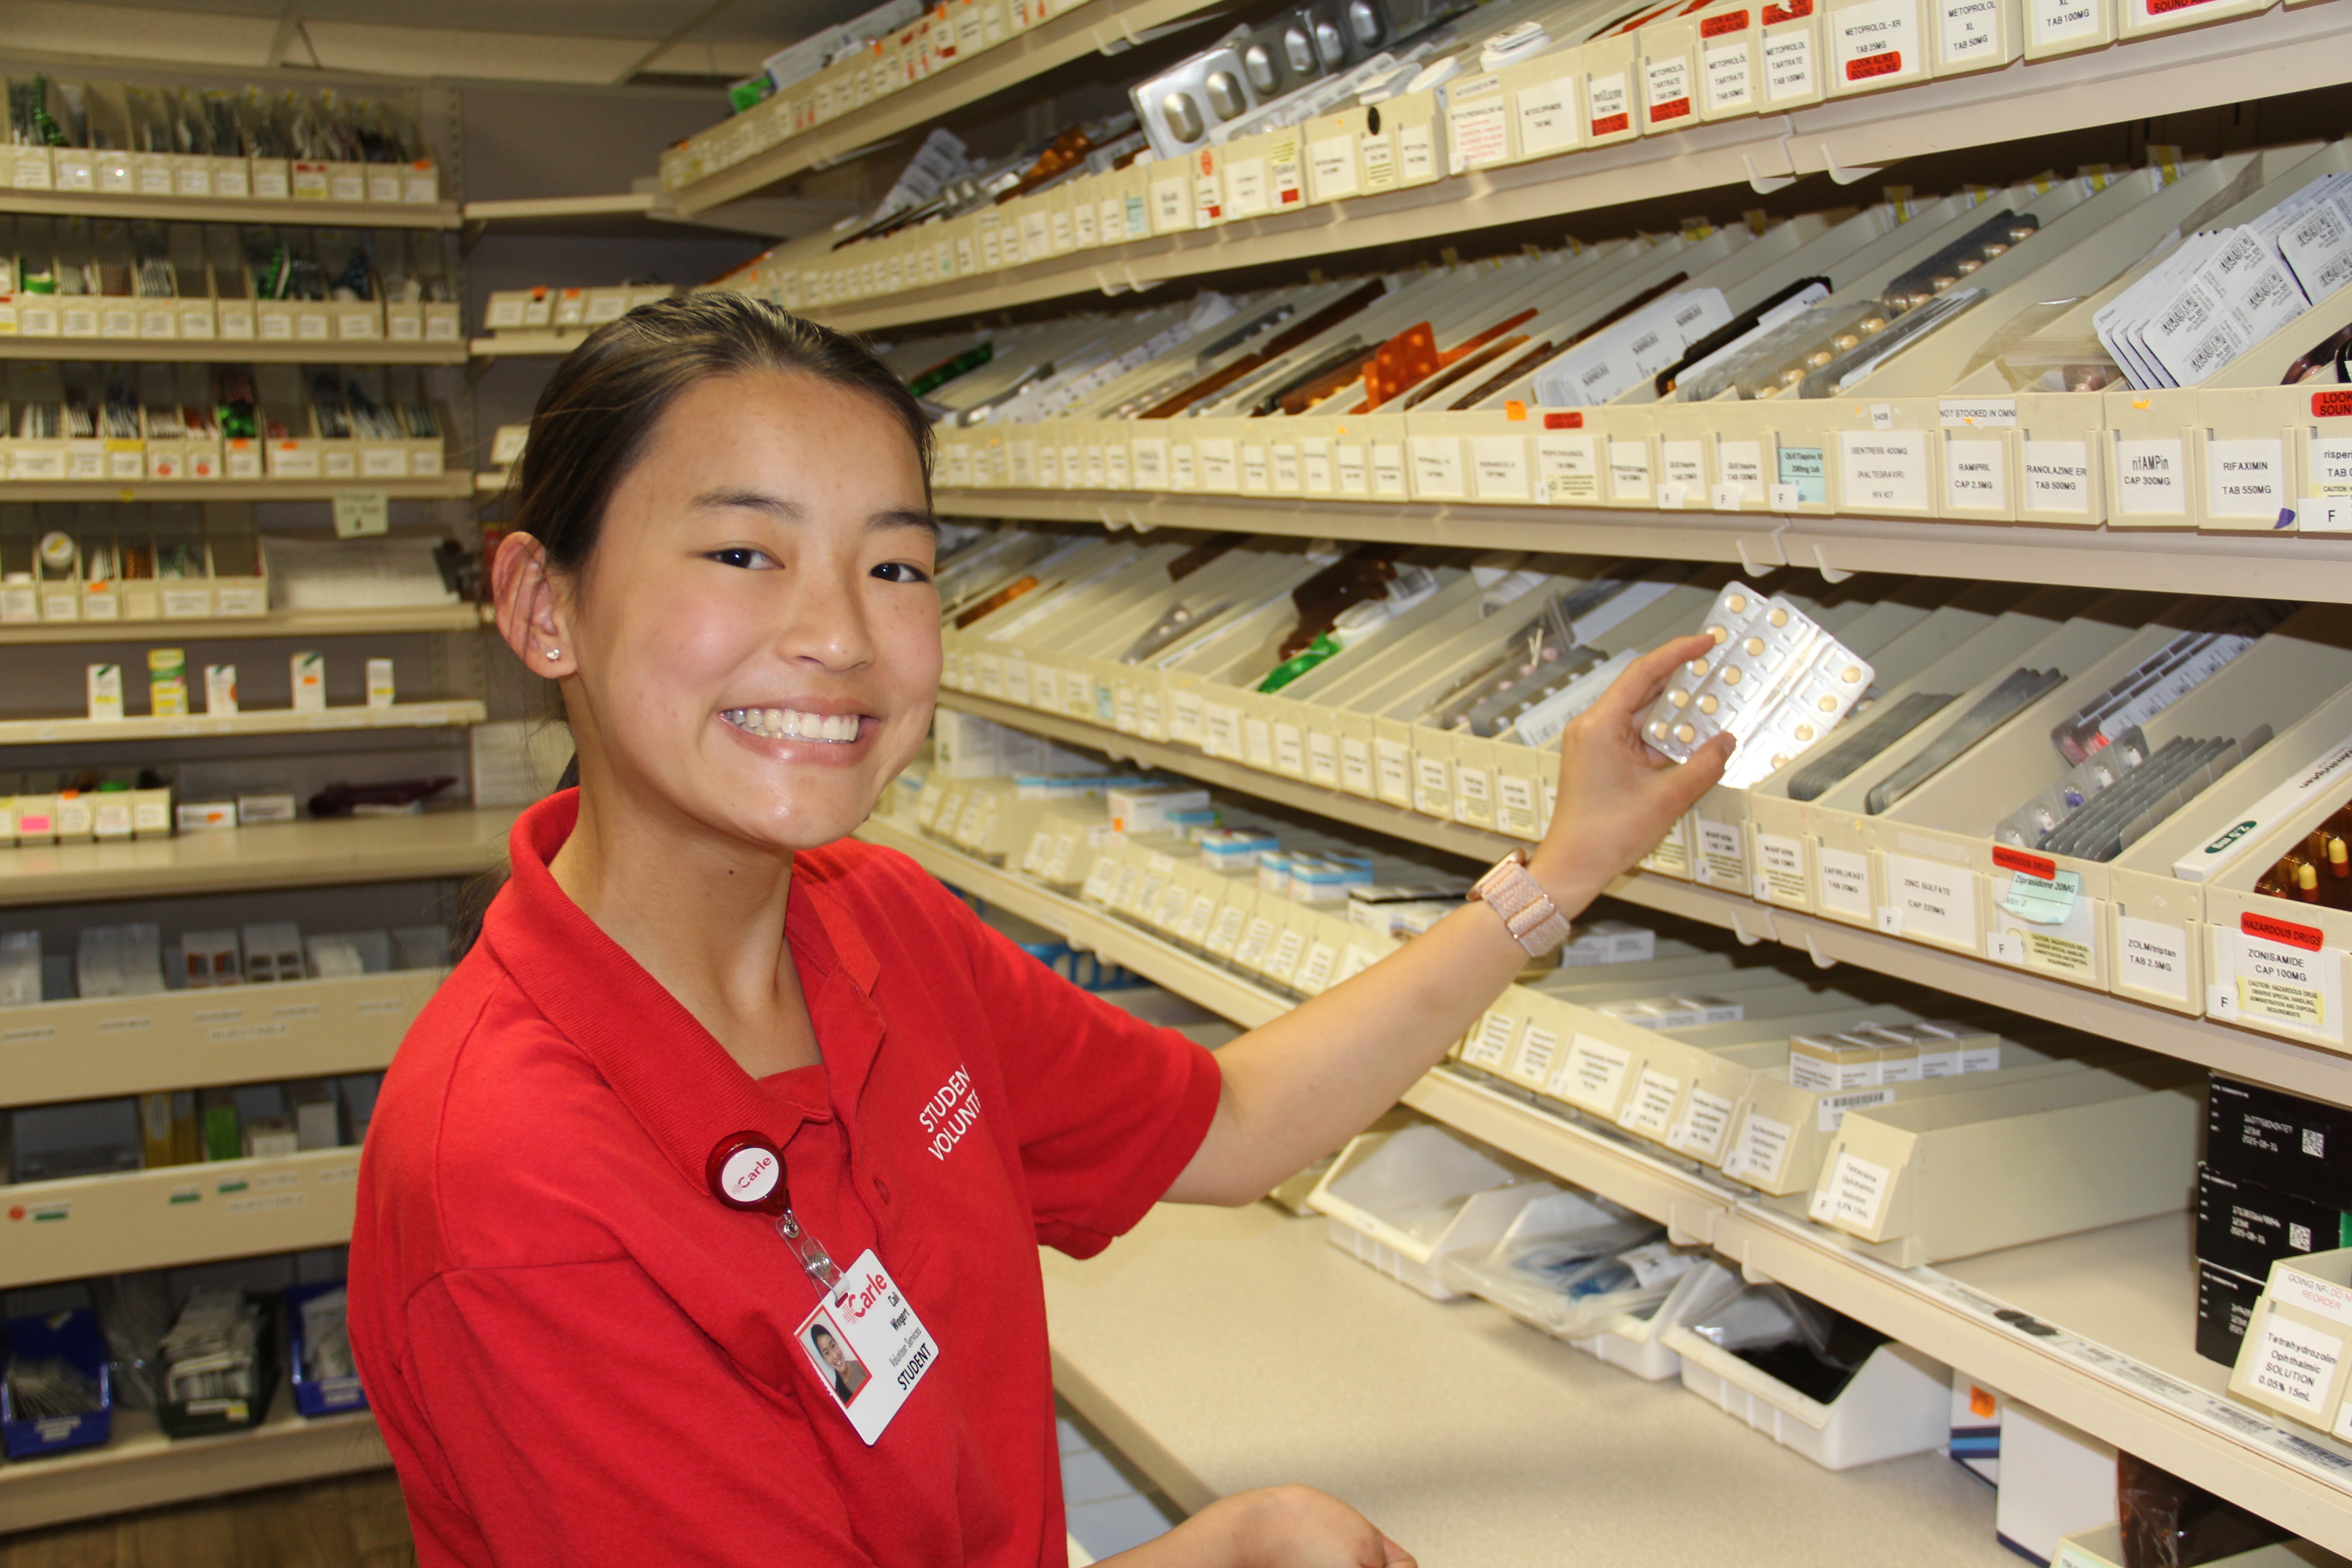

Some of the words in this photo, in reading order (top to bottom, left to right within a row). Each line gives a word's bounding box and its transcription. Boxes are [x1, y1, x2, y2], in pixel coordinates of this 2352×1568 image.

[1948, 0, 1996, 17] METOPROLOL
[2046, 15, 2063, 27] TAB
[2064, 9, 2090, 22] 100MG
[1845, 20, 1901, 36] METOPROLOL-XR
[1965, 22, 1975, 30] XL
[1765, 41, 1806, 55] METOPROLOL
[1856, 44, 1868, 54] TAB
[1868, 41, 1886, 52] 25MG
[1953, 40, 1967, 50] TAB
[1969, 35, 1988, 47] 50MG
[1709, 54, 1747, 69] METOPROLOL
[1772, 56, 1803, 69] TARTRATE
[1852, 59, 1871, 69] LOOK
[1873, 54, 1894, 64] ALIKE
[1649, 64, 1685, 78] METOPROLOL
[1851, 66, 1875, 78] SOUND
[1877, 63, 1897, 74] ALIKE
[1653, 77, 1681, 88] TARTRATE
[1715, 72, 1744, 86] TARTRATE
[1773, 76, 1786, 86] TAB
[1786, 72, 1805, 83] 100MG
[1716, 92, 1728, 100] TAB
[2323, 392, 2352, 403] LOOK
[1873, 412, 1889, 422] 340B
[1940, 409, 1954, 417] NOT
[1955, 409, 1987, 418] STOCKED
[1989, 409, 1996, 417] IN
[2320, 404, 2352, 416] SOUN
[1886, 447, 1907, 455] 400MG
[1958, 464, 1990, 472] RAMIPRIL
[2132, 455, 2169, 471] rifAMPin
[2223, 461, 2268, 471] RIFAXIMIN
[1857, 470, 1904, 480] (RALTEGRAVIR)
[2026, 465, 2073, 475] RANOLAZINE
[2075, 468, 2087, 476] ER
[2327, 468, 2347, 477] TAB
[1955, 480, 1970, 489] CAP
[1971, 480, 1992, 490] 2.5MG
[2035, 481, 2050, 490] TAB
[2052, 481, 2076, 491] 500MG
[2124, 476, 2140, 485] CAP
[2142, 476, 2170, 486] 300MG
[2222, 486, 2239, 495] TAB
[2242, 485, 2271, 495] 550MG
[1779, 493, 1784, 503] F
[2328, 510, 2336, 522] F
[1904, 878, 1919, 888] ZINC
[1922, 882, 1951, 896] SULFATE
[2015, 875, 2053, 889] Ziprasidone
[2054, 882, 2076, 893] 20MG
[1908, 900, 1921, 908] CAP
[1923, 903, 1945, 916] 220MG
[1886, 917, 1891, 926] F
[2243, 919, 2291, 939] HAZARDOUS
[2294, 931, 2322, 946] DRUGS
[1999, 944, 2004, 953] F
[2127, 938, 2176, 958] ZOLMitriptan
[2129, 954, 2145, 965] TAB
[2148, 958, 2171, 972] 2.5MG
[2248, 948, 2304, 967] ZONISAMIDE
[2255, 965, 2274, 975] CAP
[2277, 969, 2307, 981] 100MG
[2220, 996, 2228, 1008] F
[920, 1063, 970, 1132] STUDEN
[928, 1089, 981, 1161] VOLUNT
[738, 1157, 772, 1188] Carle
[2288, 1273, 2314, 1289] GOING
[2330, 1288, 2343, 1298] DO
[848, 1273, 888, 1318] Carle
[888, 1293, 901, 1307] Cali
[2302, 1290, 2341, 1309] REORDER
[890, 1308, 910, 1331] Wingert
[888, 1344, 907, 1367] Volunteer
[904, 1327, 922, 1348] Services
[897, 1343, 931, 1391] STUDENT
[2271, 1350, 2321, 1374] Ophthalmic
[2265, 1362, 2315, 1387] SOLUTION
[2259, 1375, 2284, 1392] 0.05%
[2288, 1385, 2311, 1402] 15mL
